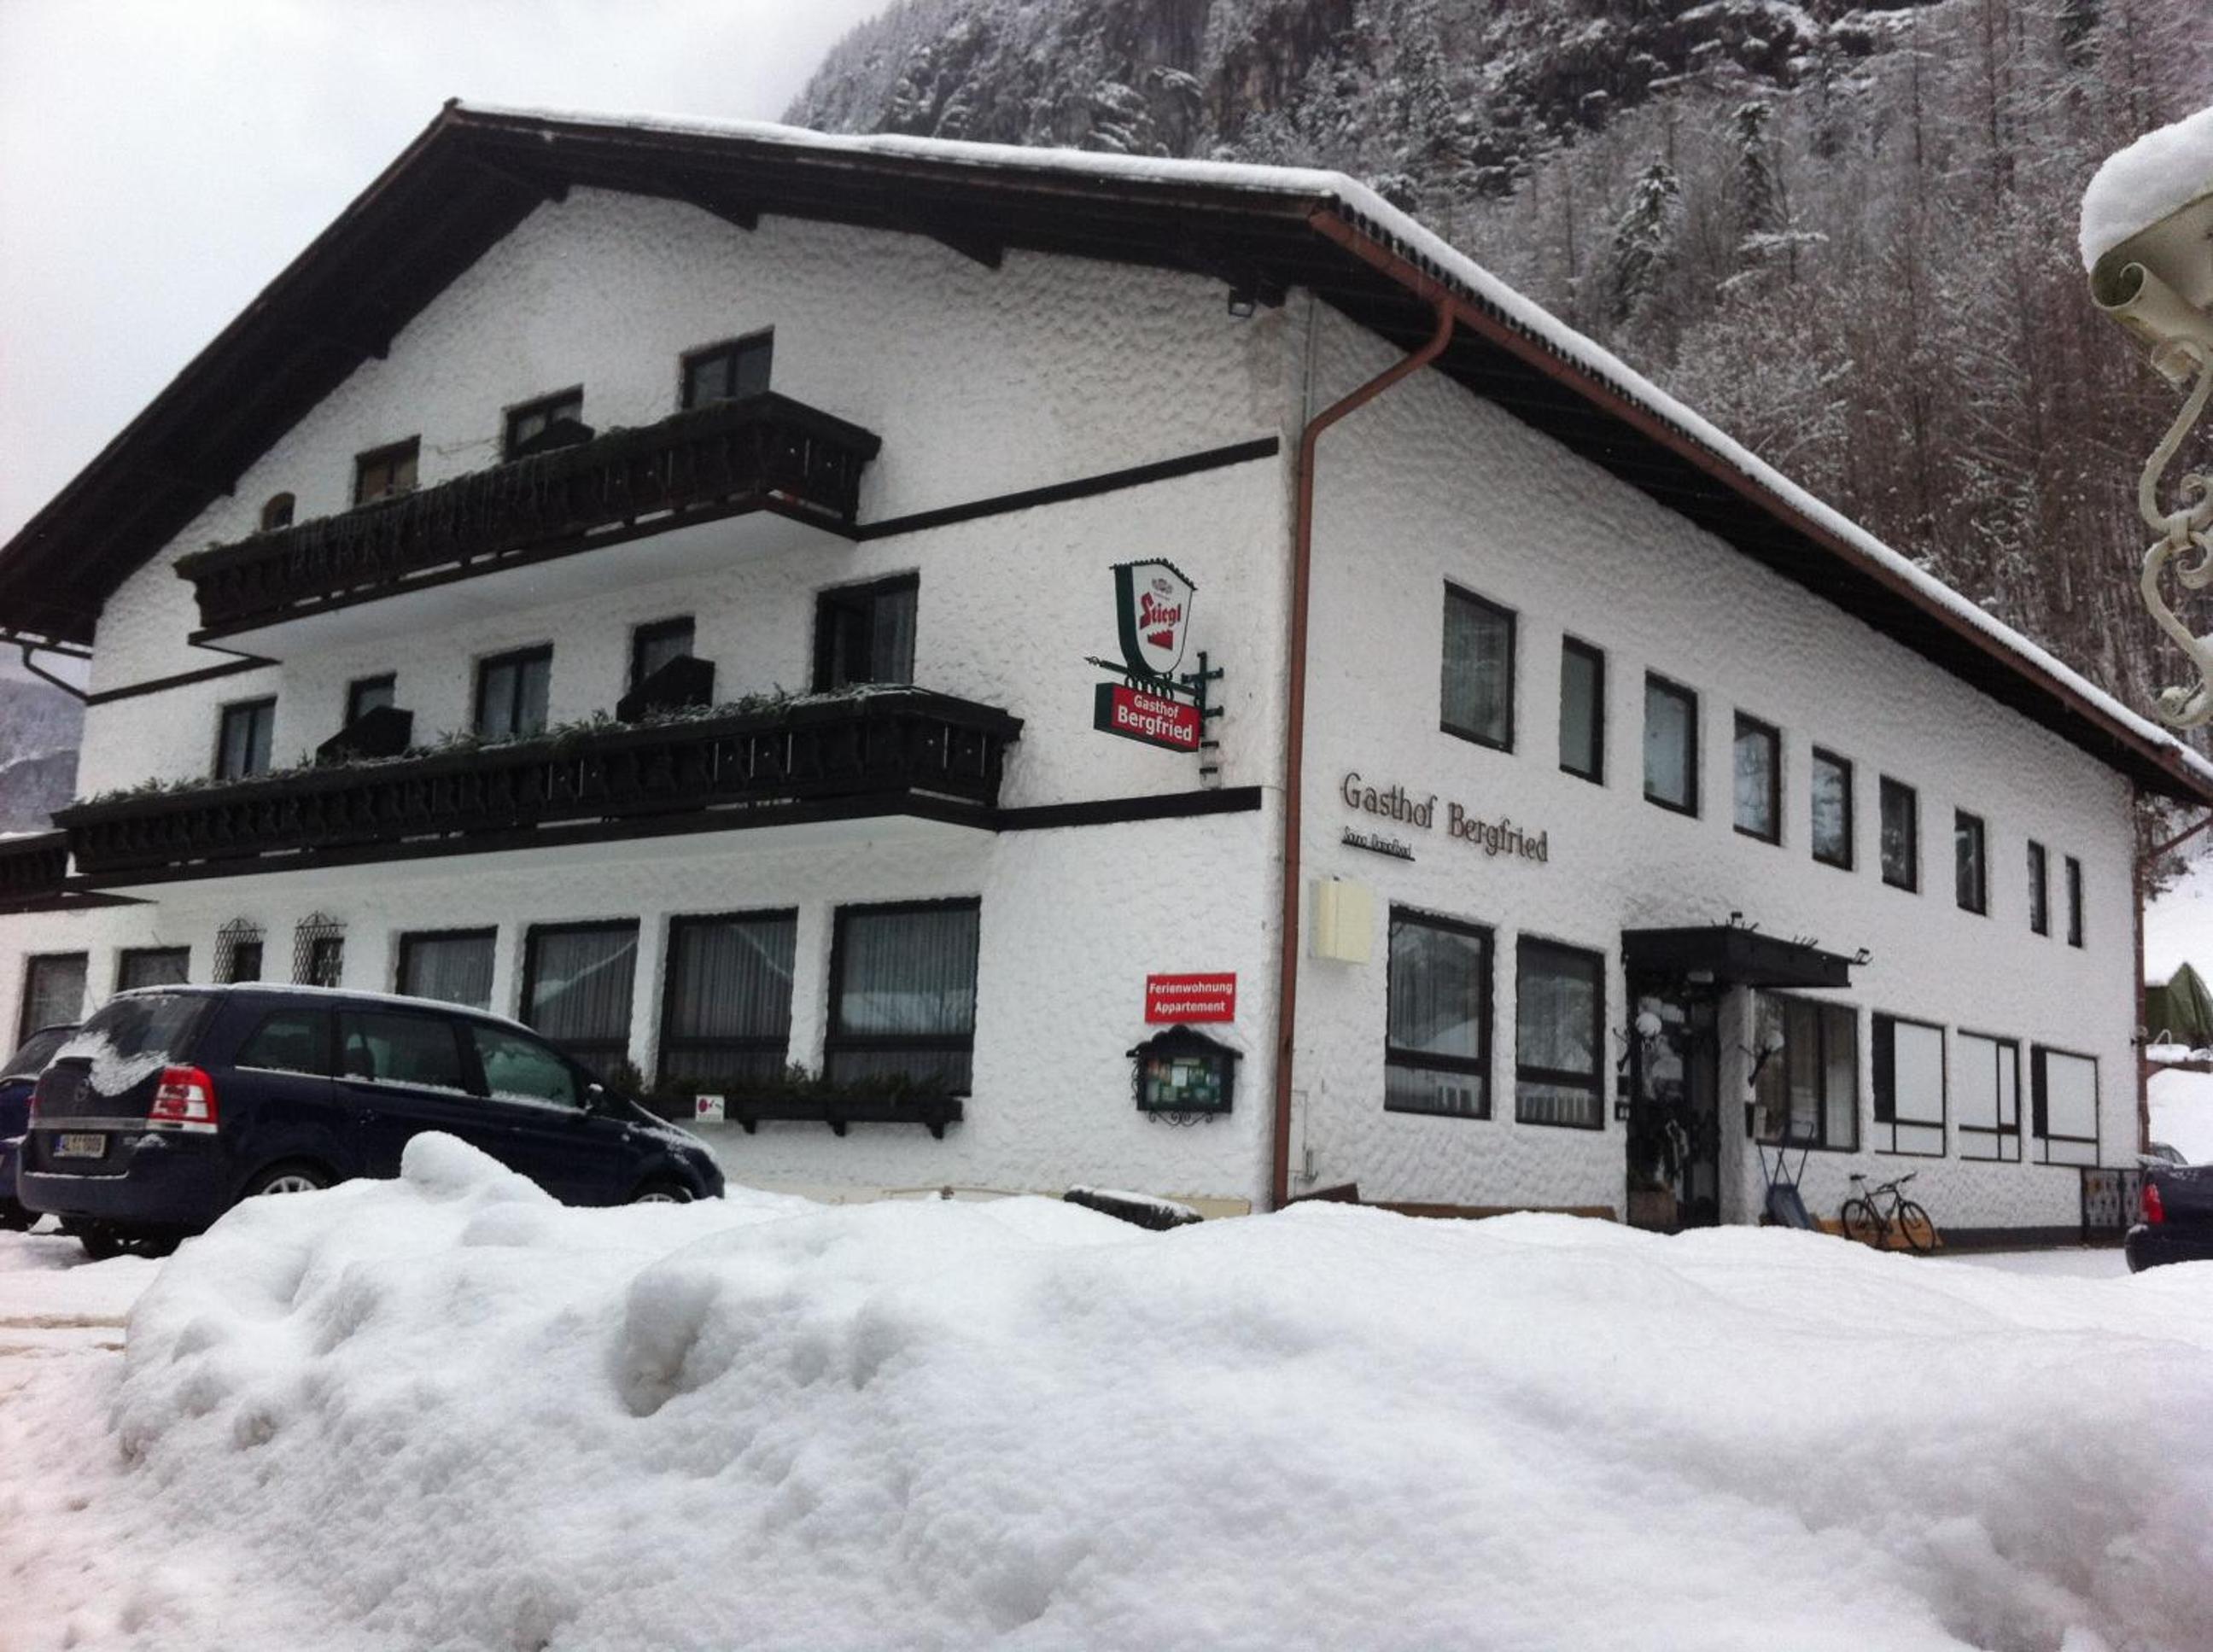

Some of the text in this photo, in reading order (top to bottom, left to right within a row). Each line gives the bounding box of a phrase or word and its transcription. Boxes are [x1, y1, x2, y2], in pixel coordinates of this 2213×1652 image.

[1140, 592, 1181, 629] Stiegl
[1134, 694, 1179, 719] Gasthof
[1118, 706, 1192, 741] Bergfried
[1343, 772, 1548, 862] Gasthof Bergfried
[1149, 981, 1233, 995] Ferienwohnung
[1154, 1001, 1225, 1013] Appartement
